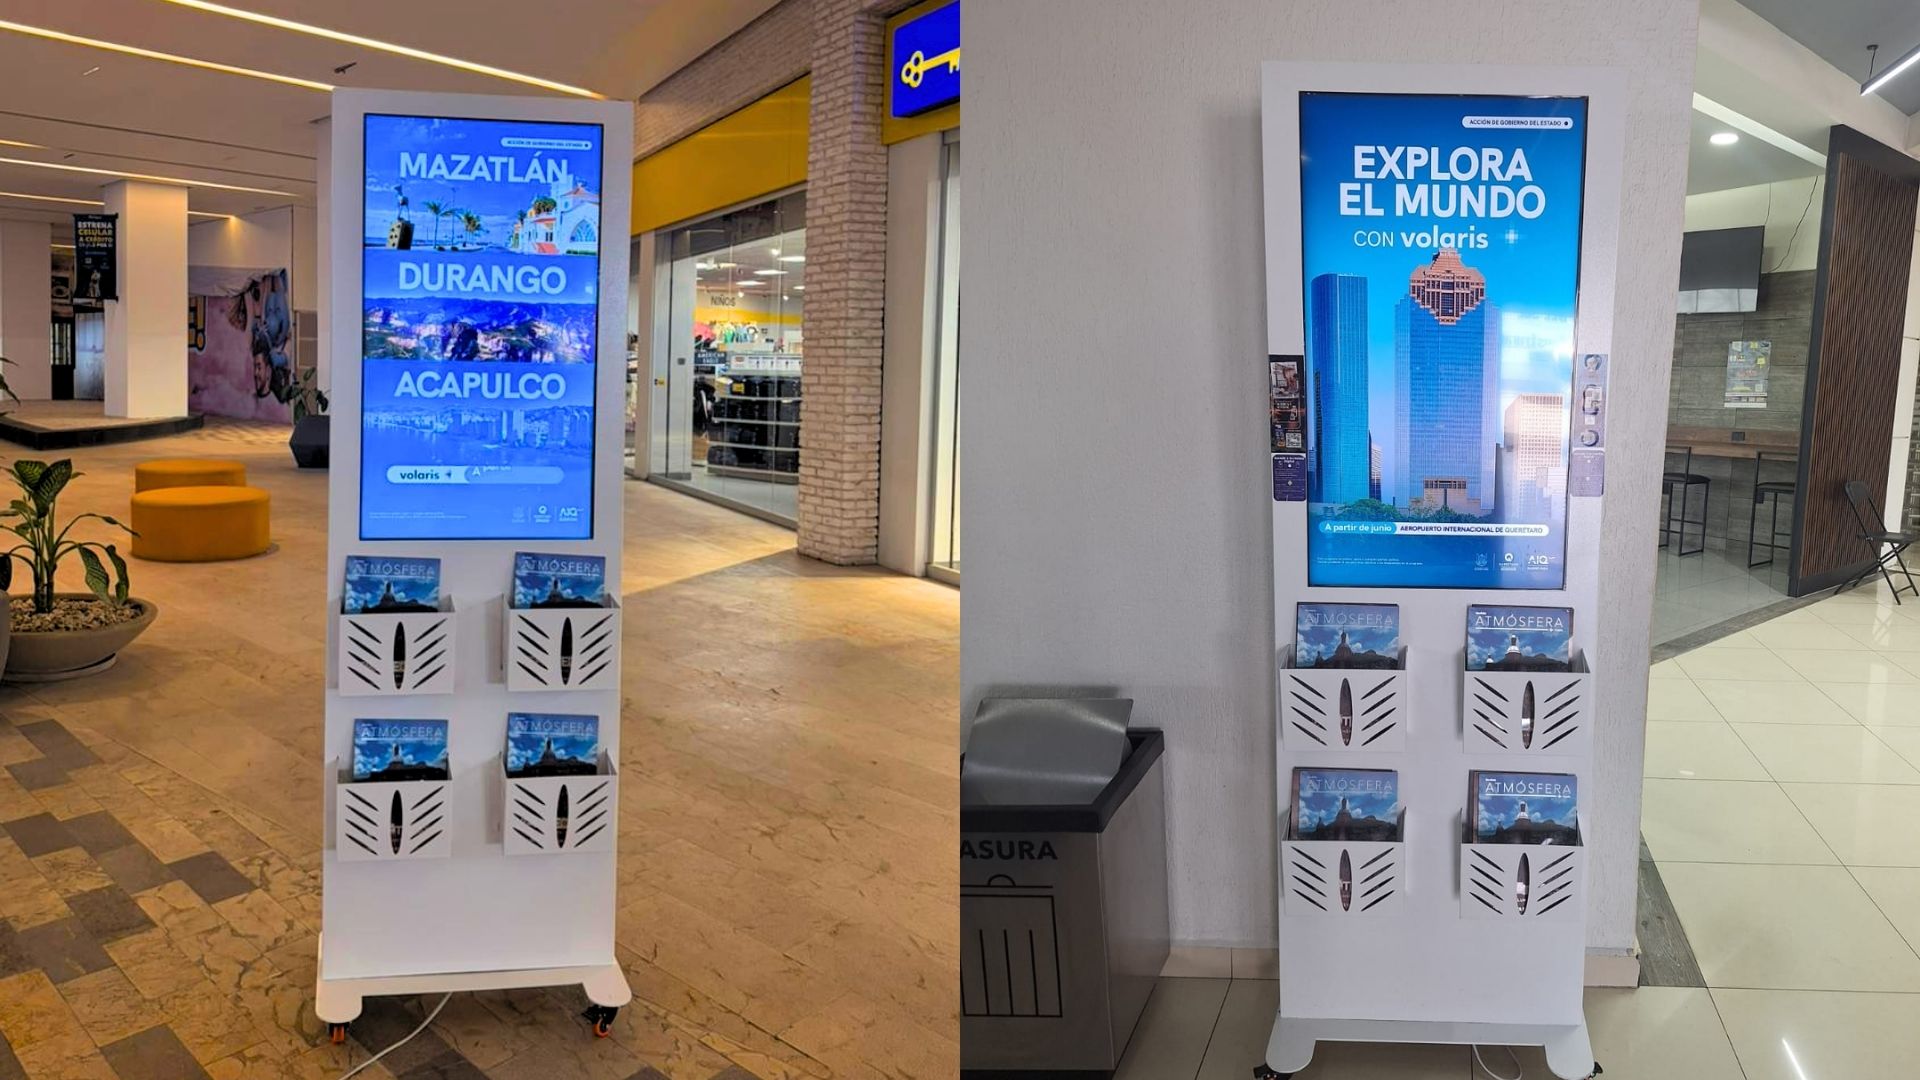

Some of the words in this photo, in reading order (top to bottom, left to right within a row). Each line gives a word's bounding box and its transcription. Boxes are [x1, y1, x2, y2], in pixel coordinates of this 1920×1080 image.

[400, 151, 568, 184] MAZATLÁN
[1353, 145, 1533, 182] EXPLORA
[1339, 182, 1384, 216] EL
[1395, 183, 1546, 219] MUNDO
[78, 221, 113, 229] ESTRENA
[1353, 230, 1394, 247] CON
[1400, 224, 1489, 249] volaris
[399, 262, 567, 294] DURANGO
[711, 294, 736, 306] NIÑOS
[394, 370, 567, 400] ACAPULCO
[400, 469, 440, 480] volaris
[1333, 523, 1357, 533] partir
[1359, 523, 1369, 531] de
[1370, 523, 1392, 533] junio
[520, 559, 600, 573] ATMÓSFERA
[1528, 555, 1549, 565] AIQ
[352, 560, 435, 575] ATMÓSFERA
[1304, 611, 1393, 625] ATMÓSFERA
[1475, 613, 1564, 628] ATMÓSFERA
[361, 725, 443, 737] ATMÓSFERA
[514, 719, 594, 732] ATMÓSFERA
[1306, 777, 1393, 791] ATMÓSFERA
[1485, 780, 1571, 794] ATMÓSFERA
